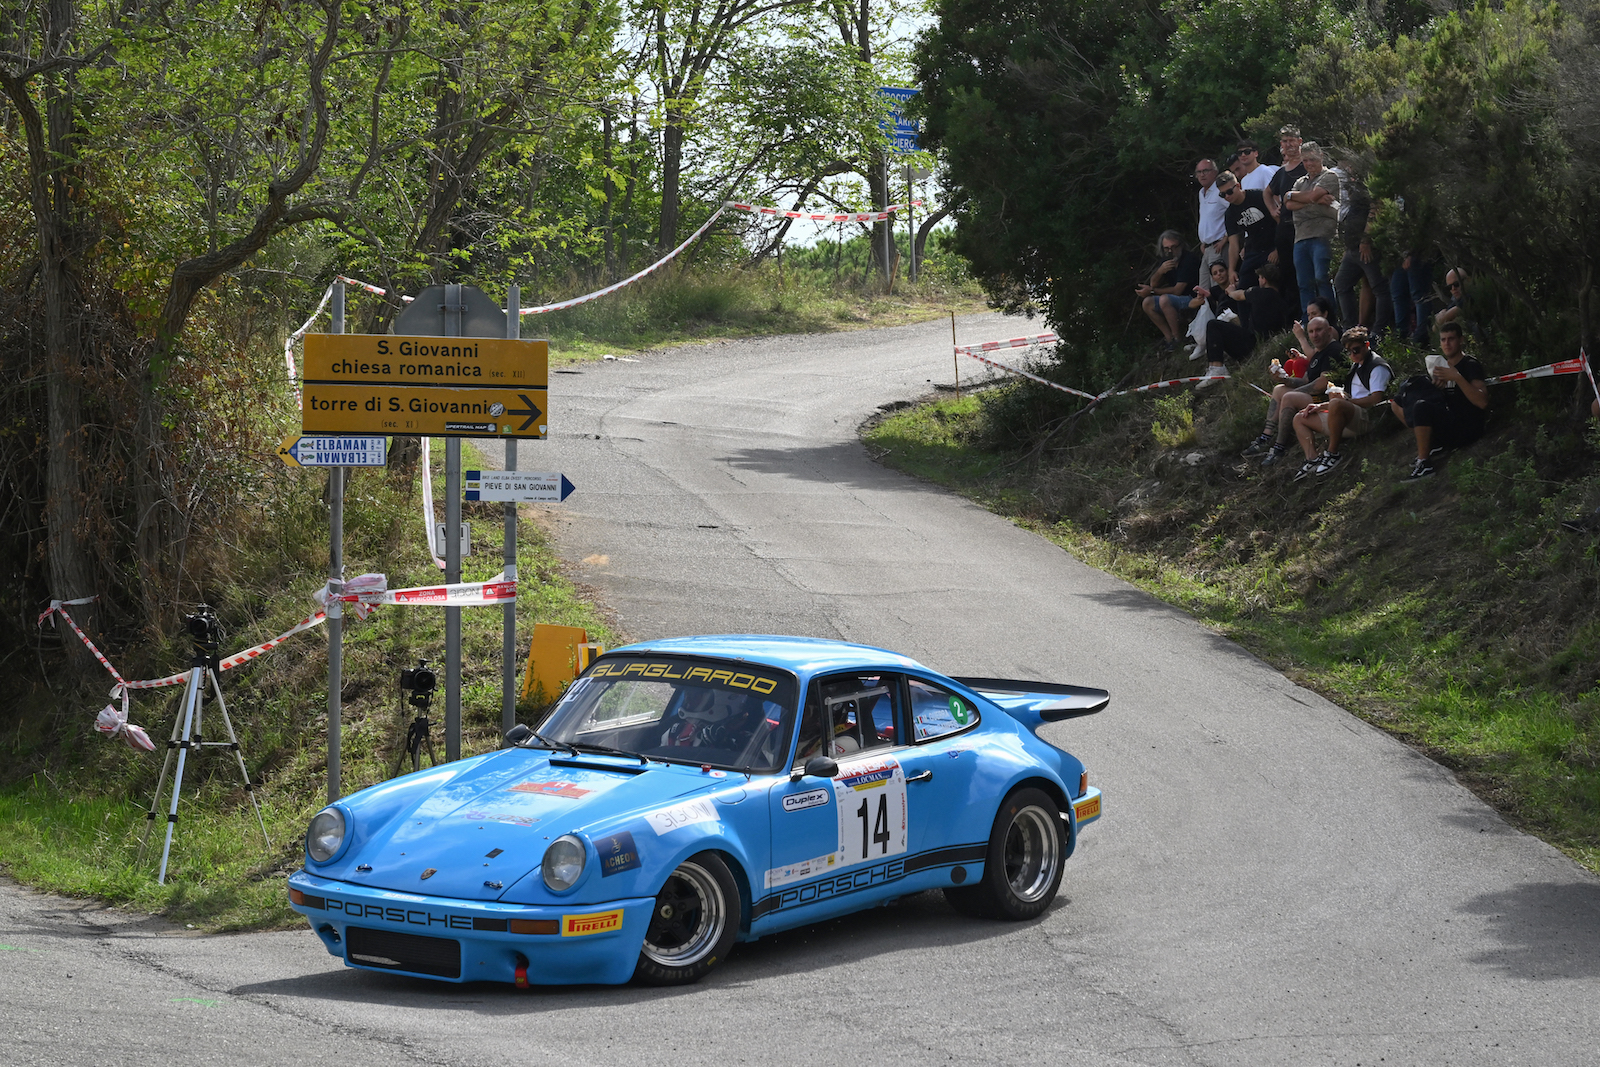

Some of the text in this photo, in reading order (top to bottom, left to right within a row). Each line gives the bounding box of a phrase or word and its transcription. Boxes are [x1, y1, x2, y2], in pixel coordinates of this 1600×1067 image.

[377, 340, 479, 358] S. Giovanni
[331, 359, 391, 375] chiesa
[399, 362, 482, 377] romanica
[489, 368, 506, 379] (sec.
[311, 395, 488, 415] torre di S. Giovanni
[381, 419, 399, 429] (sec.
[316, 439, 367, 450] ELBAMAN
[316, 452, 367, 463] ELBAMAN
[484, 482, 502, 490] PIEVE
[529, 483, 557, 491] GIOVANNI
[409, 594, 446, 602] PERICOLOSA
[589, 663, 778, 695] GUAGLIARDO
[953, 701, 964, 718] 2
[856, 772, 884, 785] LOCMAN
[786, 794, 823, 806] Duplex
[1076, 800, 1099, 819] PIRELLI
[857, 793, 890, 859] 14
[780, 861, 903, 908] PORSCHE
[325, 898, 473, 930] PORSCHE
[568, 913, 618, 933] PIRELLI
